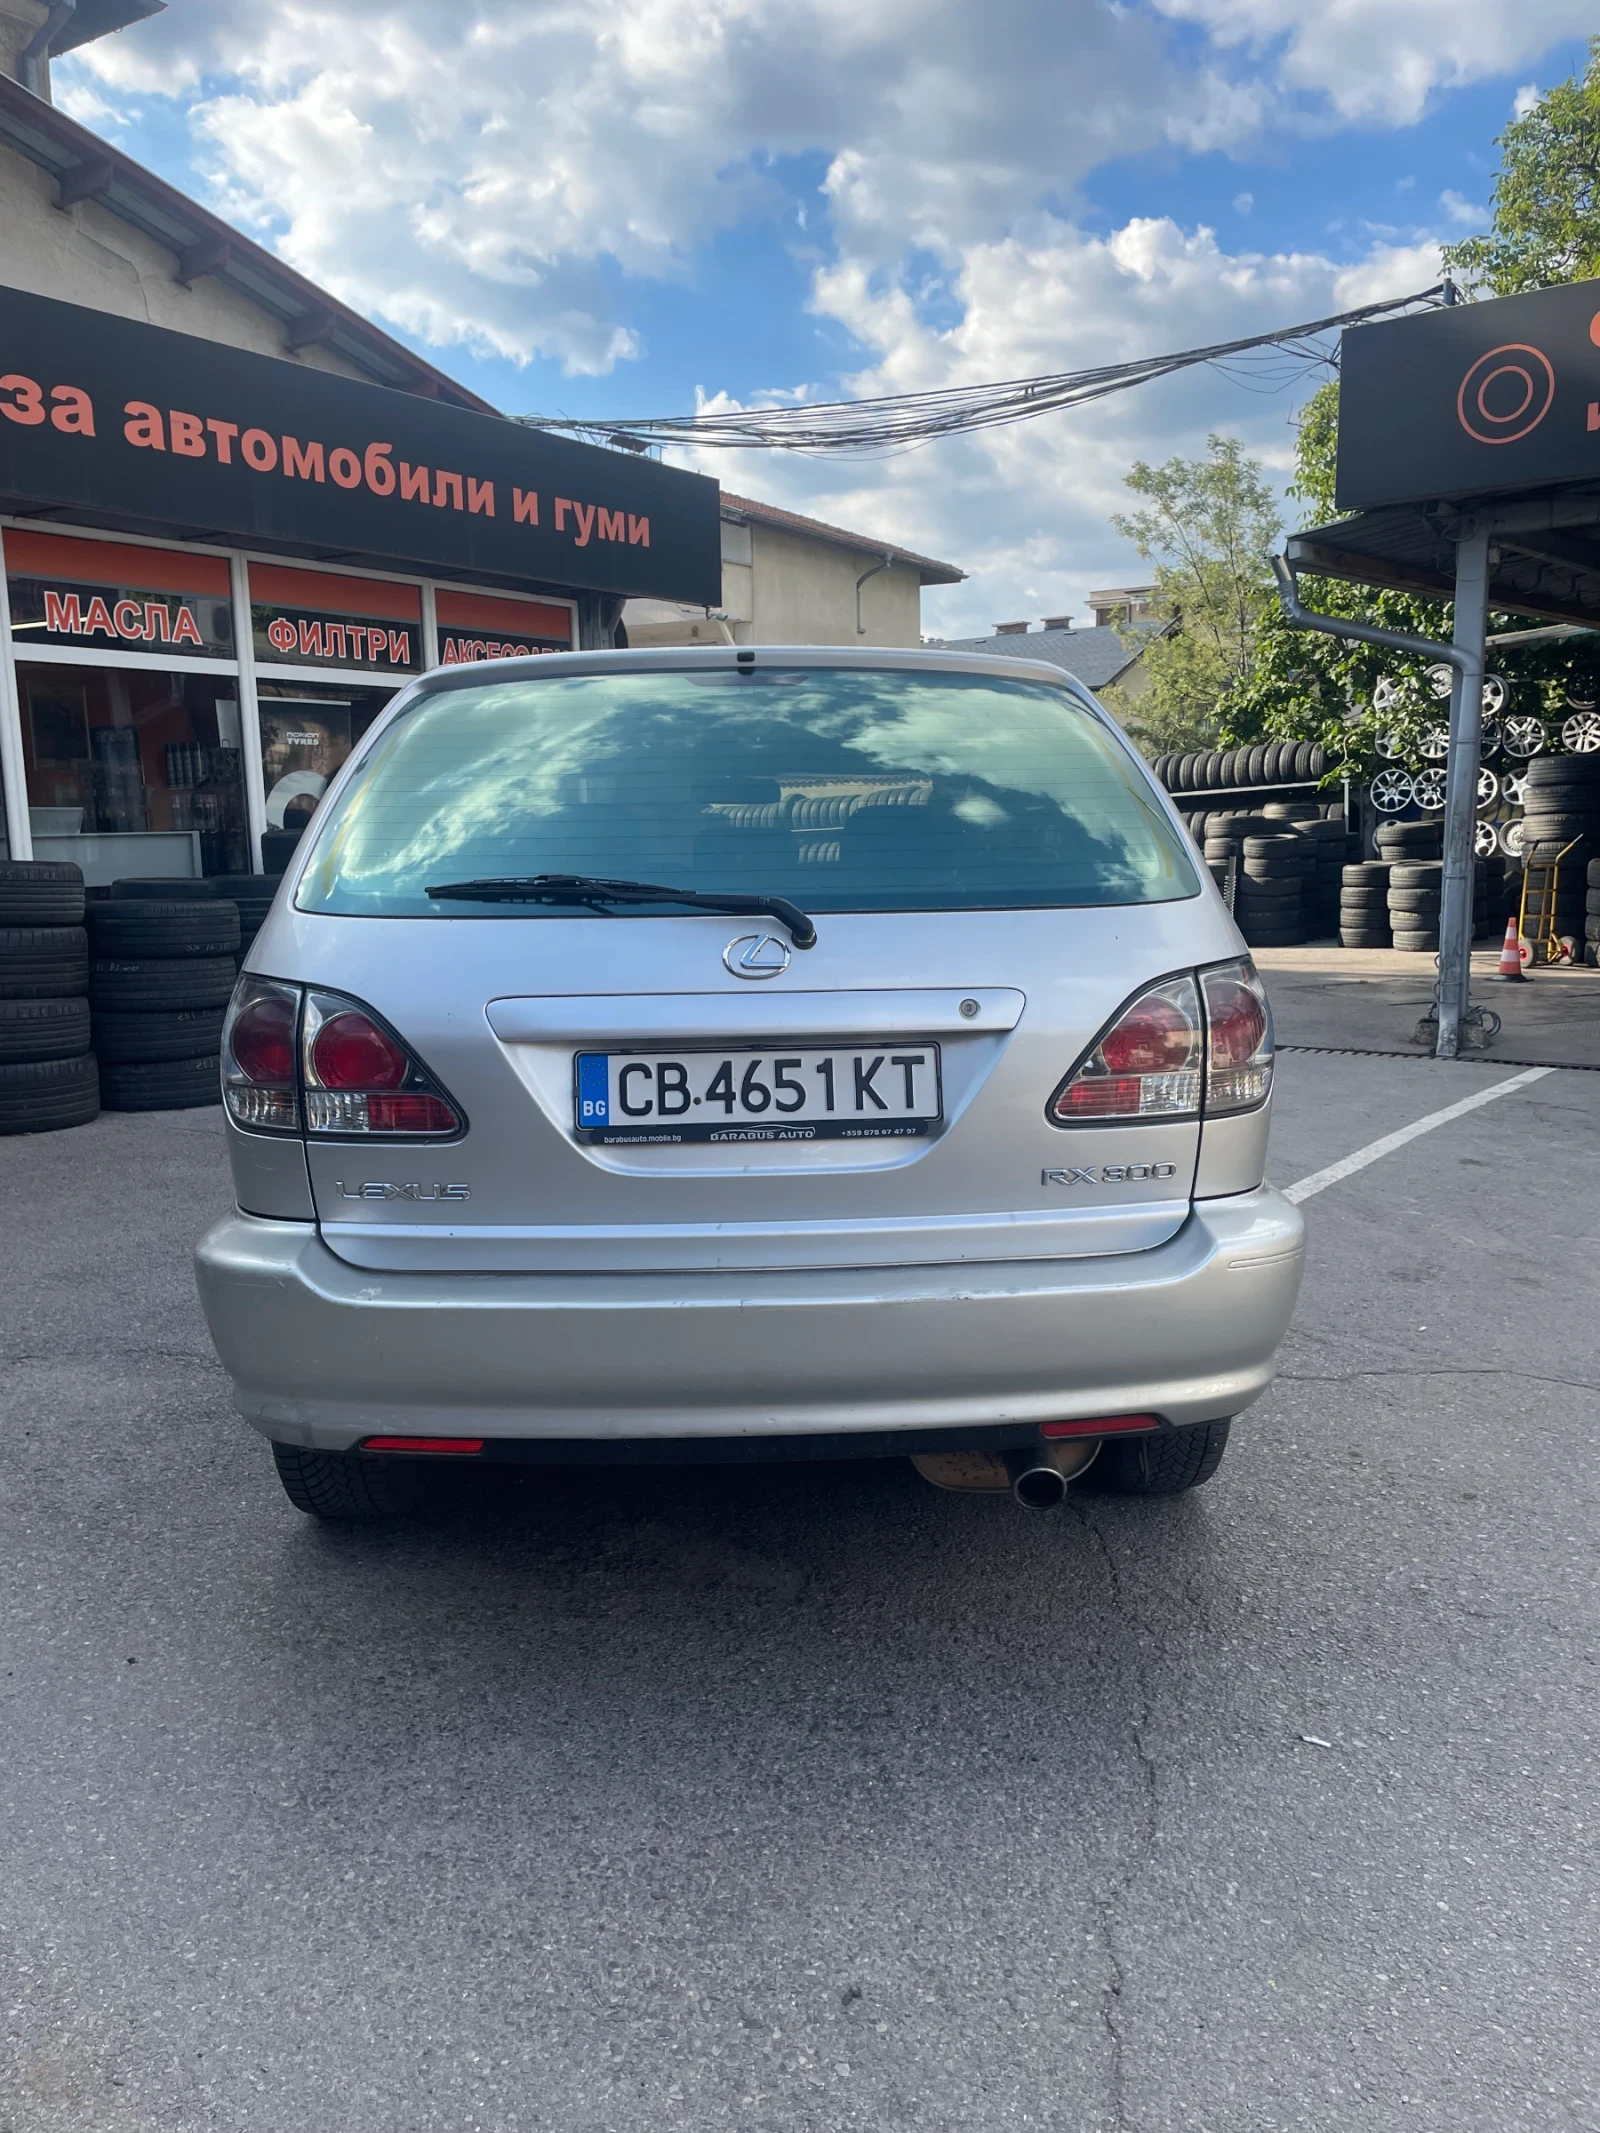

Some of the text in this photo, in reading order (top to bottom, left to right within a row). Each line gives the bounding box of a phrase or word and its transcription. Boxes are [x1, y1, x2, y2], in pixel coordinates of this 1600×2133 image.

[0, 374, 649, 546] за автомобили и гуми
[44, 591, 203, 645] МАСЛА
[268, 618, 411, 664] ФИЛТРИ
[705, 1058, 835, 1115] 4651
[853, 1055, 926, 1111] KT
[583, 1100, 607, 1117] BG
[604, 1134, 682, 1144] barabusauto.mobile.bg
[710, 1130, 814, 1141] BARABUS AUTO
[841, 1129, 862, 1137] +359
[881, 1128, 892, 1136] 67
[906, 1127, 917, 1135] 97
[1040, 1160, 1178, 1187] RX 300
[335, 1180, 472, 1201] LEXUS
